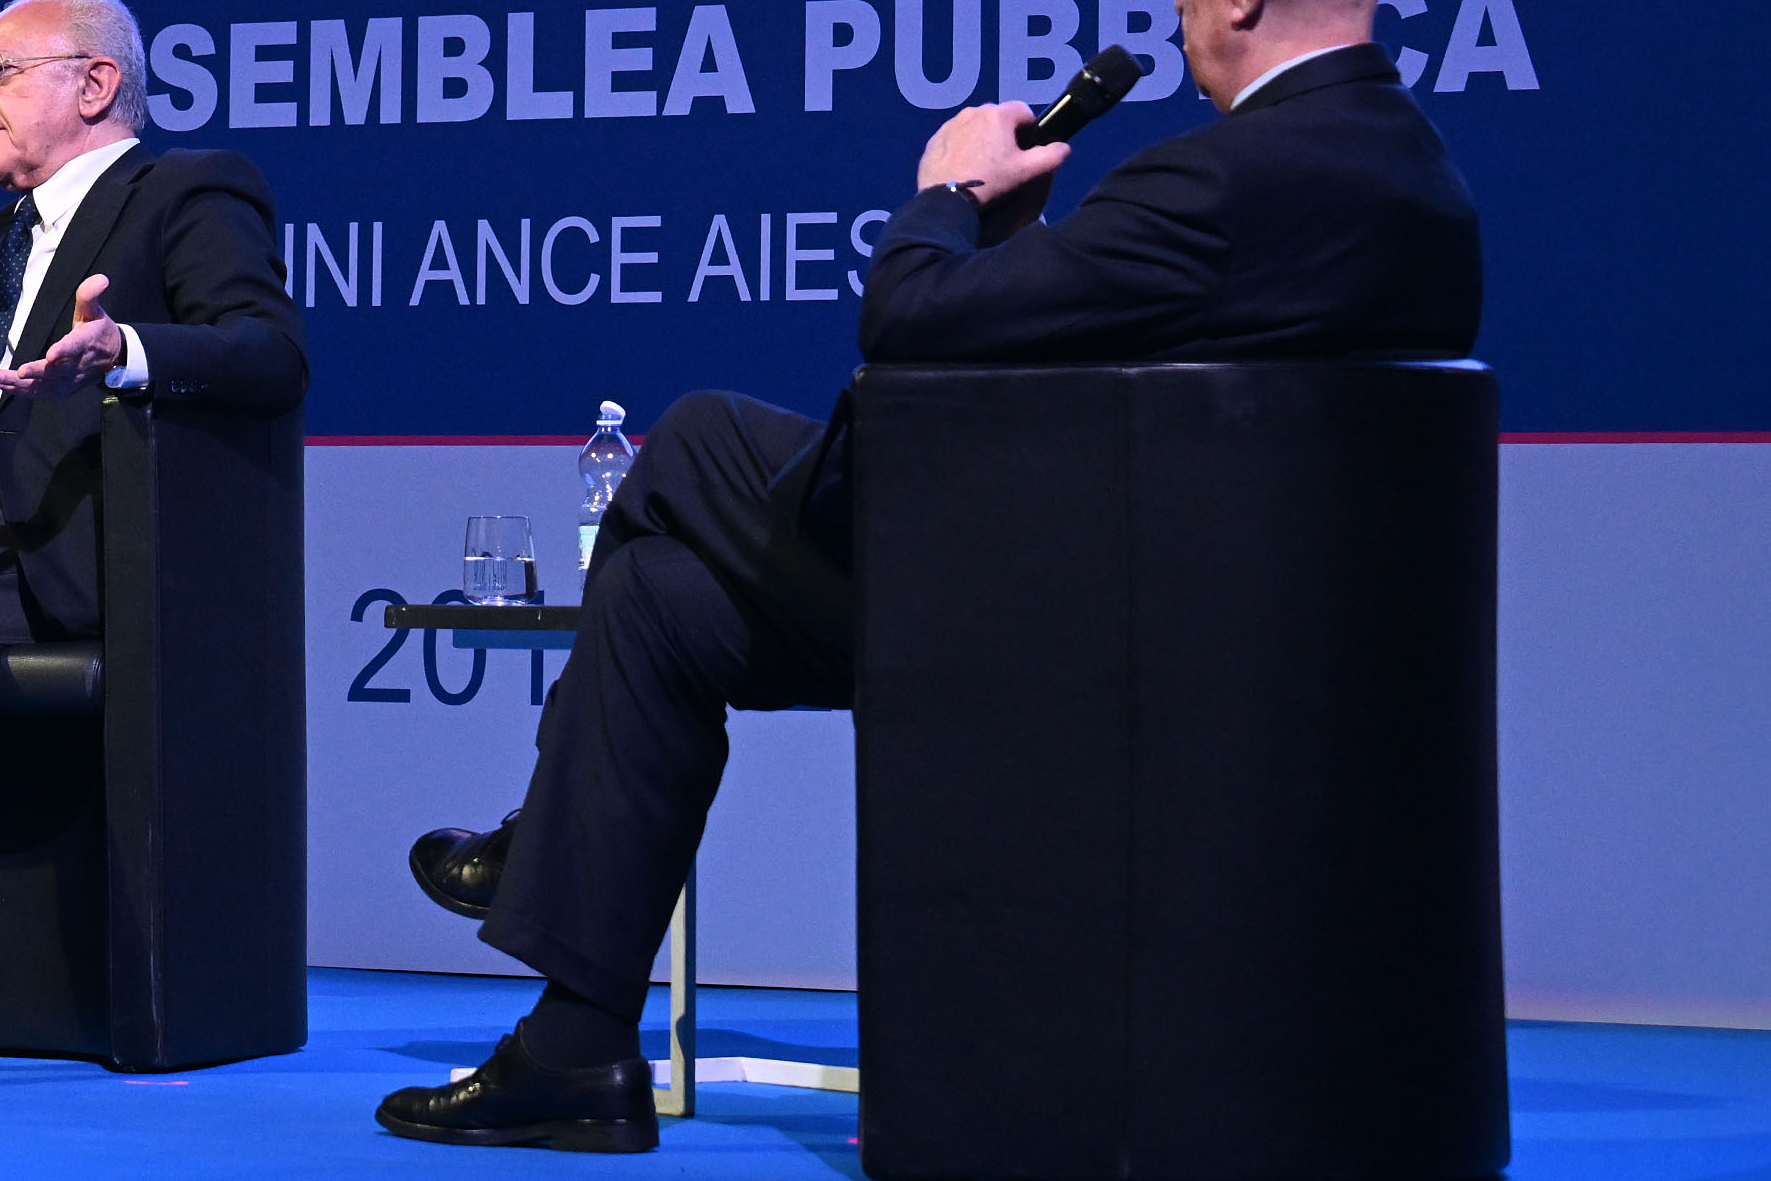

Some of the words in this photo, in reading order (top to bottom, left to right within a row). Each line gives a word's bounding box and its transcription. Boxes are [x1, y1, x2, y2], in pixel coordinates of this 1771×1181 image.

[149, 3, 756, 132] SEMBLEA
[409, 215, 663, 307] ANCE
[686, 209, 893, 303] AIES
